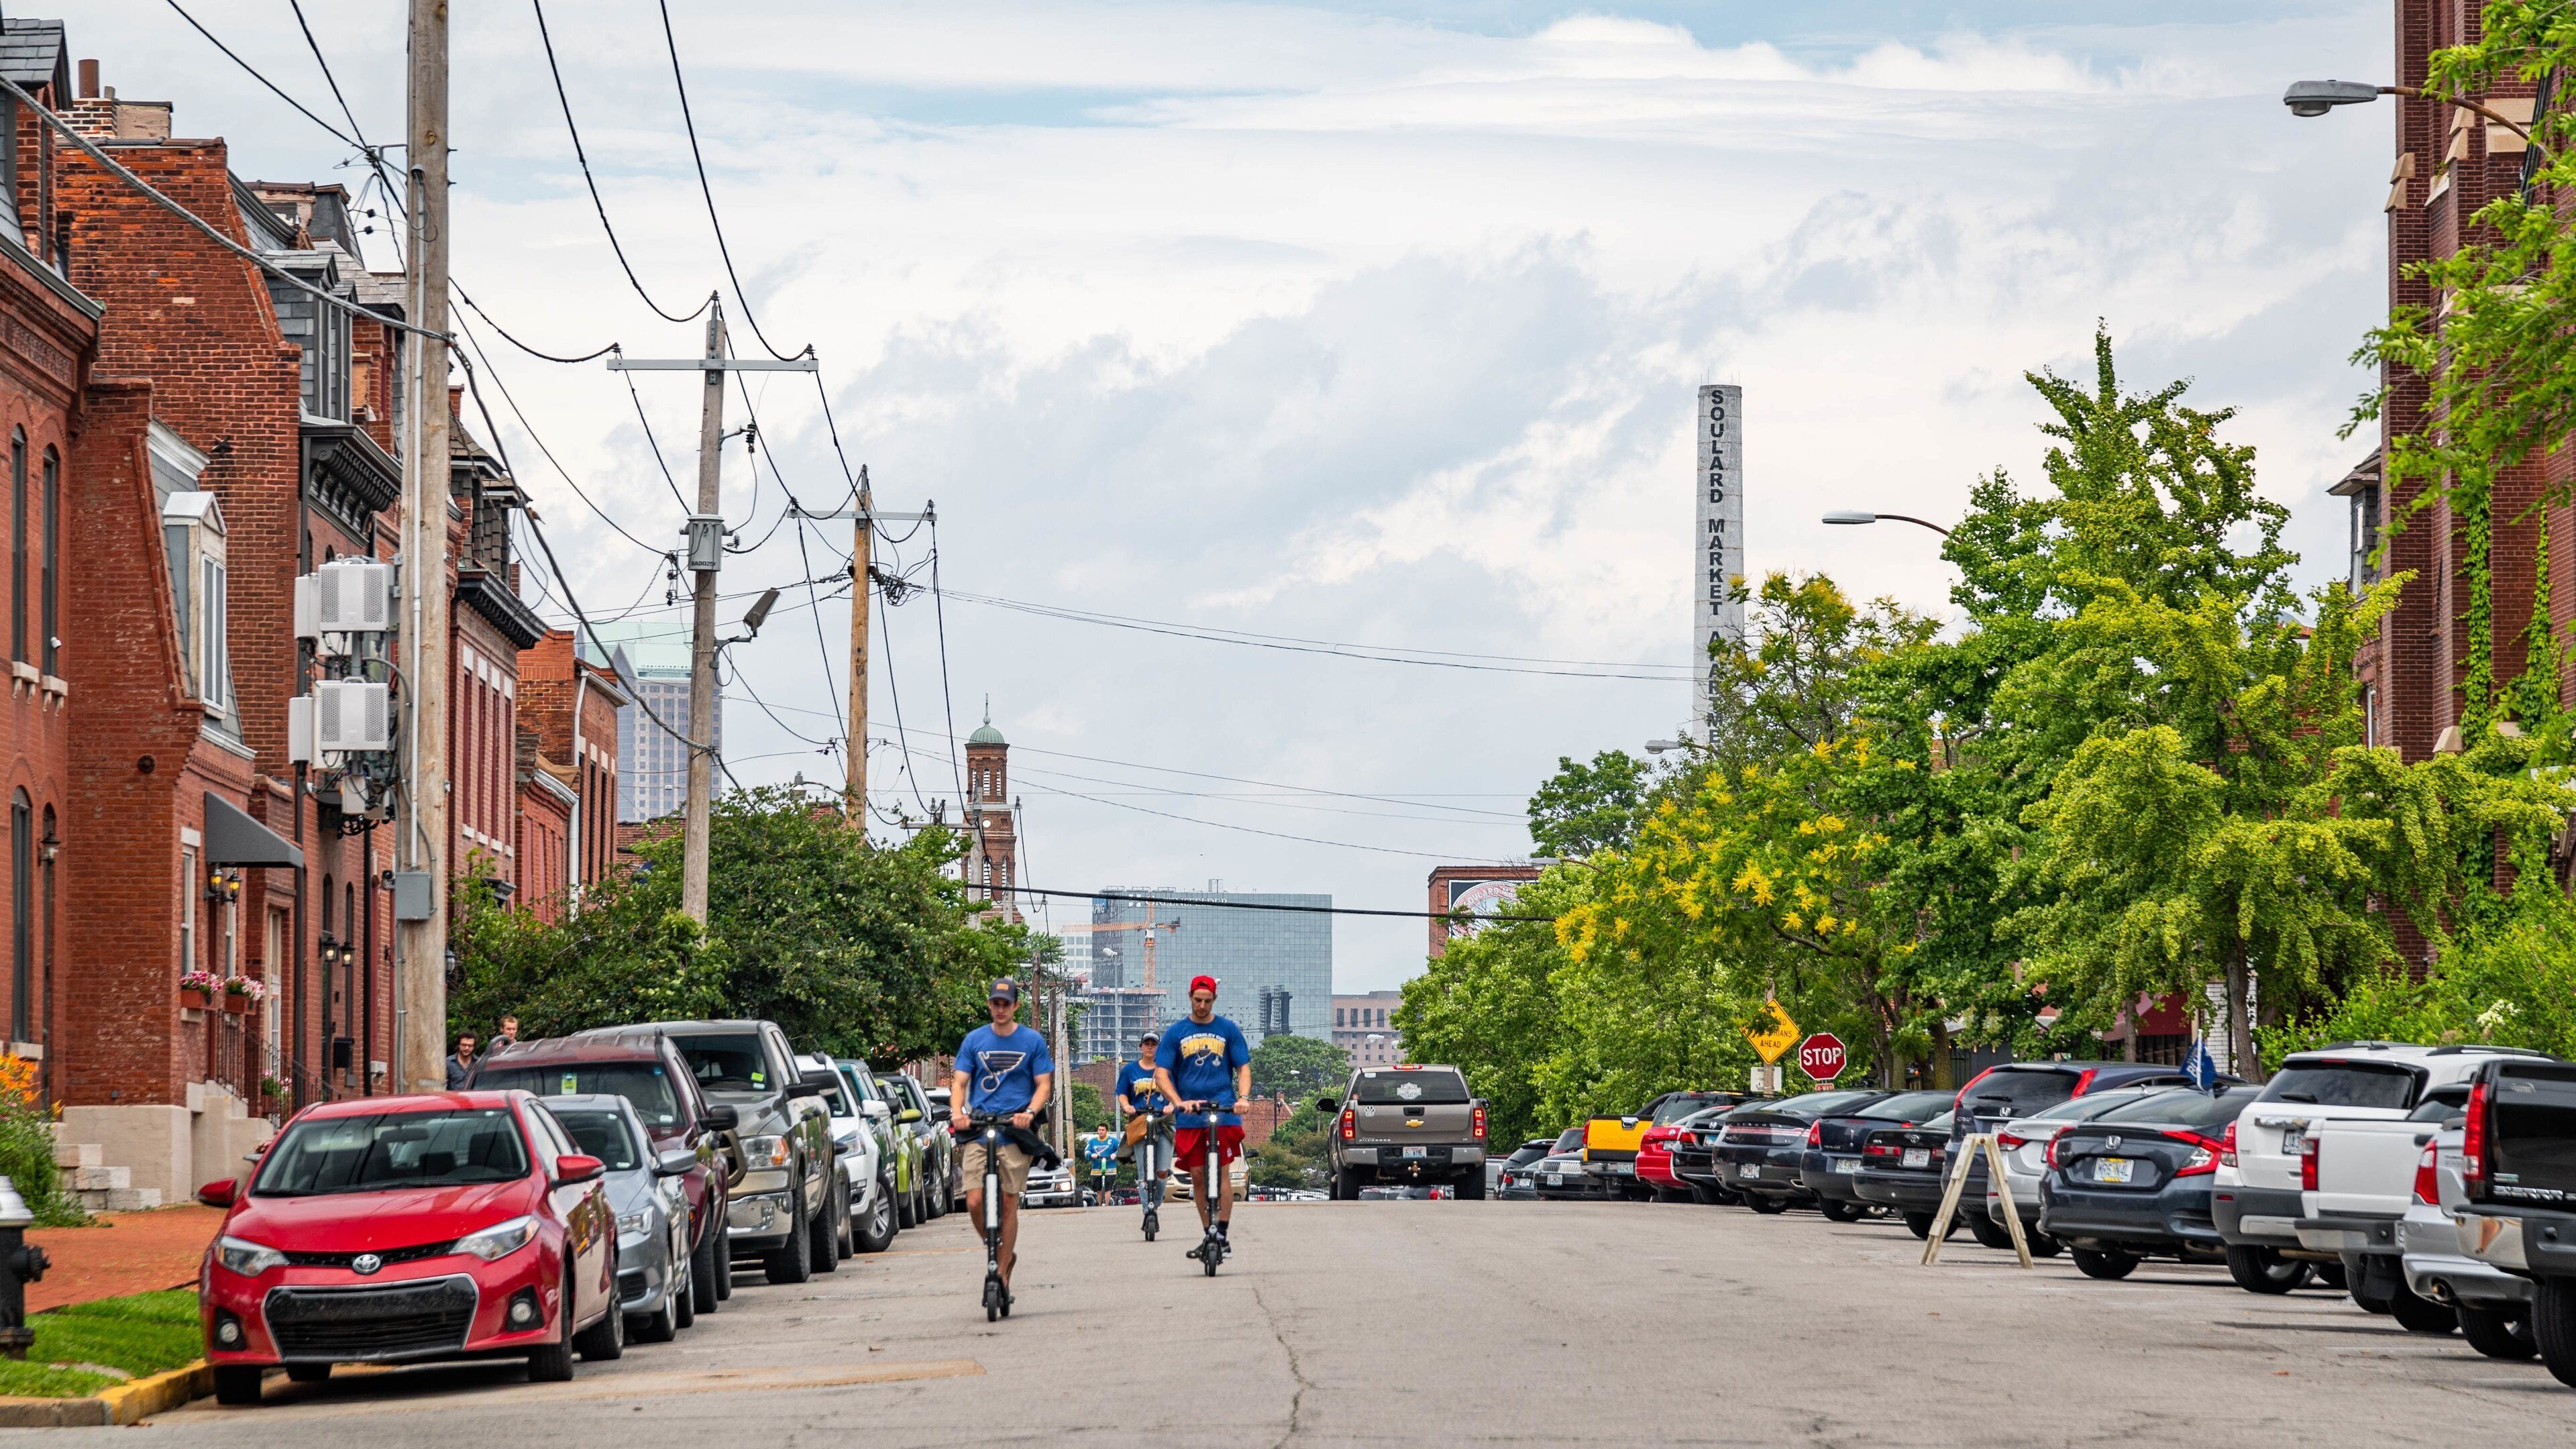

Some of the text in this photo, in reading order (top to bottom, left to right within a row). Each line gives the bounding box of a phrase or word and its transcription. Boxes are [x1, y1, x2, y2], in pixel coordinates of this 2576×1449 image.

[1709, 390, 1725, 503] SOULARD
[1709, 519, 1725, 616] MARKET
[1465, 887, 1499, 907] SOULARD
[1092, 902, 1106, 914] KPMG
[1760, 1040, 1781, 1048] AHEAD
[1803, 1046, 1842, 1066] STOP
